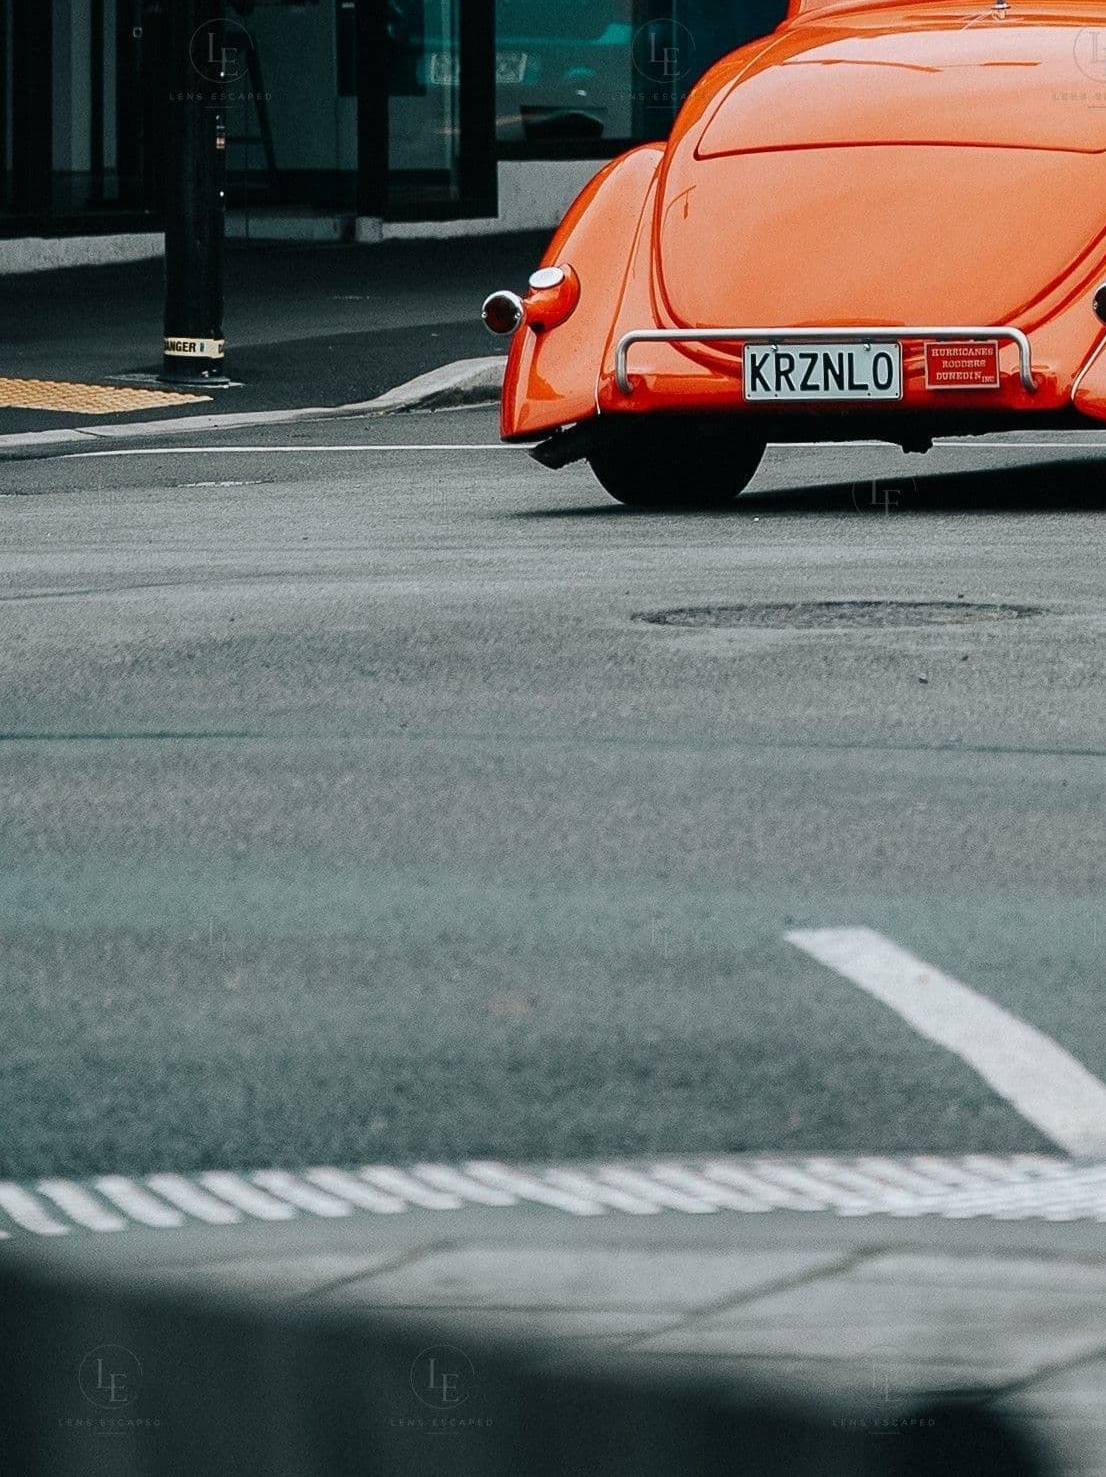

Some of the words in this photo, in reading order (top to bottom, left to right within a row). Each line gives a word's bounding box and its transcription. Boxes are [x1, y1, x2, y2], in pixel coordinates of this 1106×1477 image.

[931, 347, 994, 358] HURRICANES
[942, 359, 986, 369] RODDERS
[935, 370, 982, 382] DUNEDIN
[981, 375, 995, 384] INC
